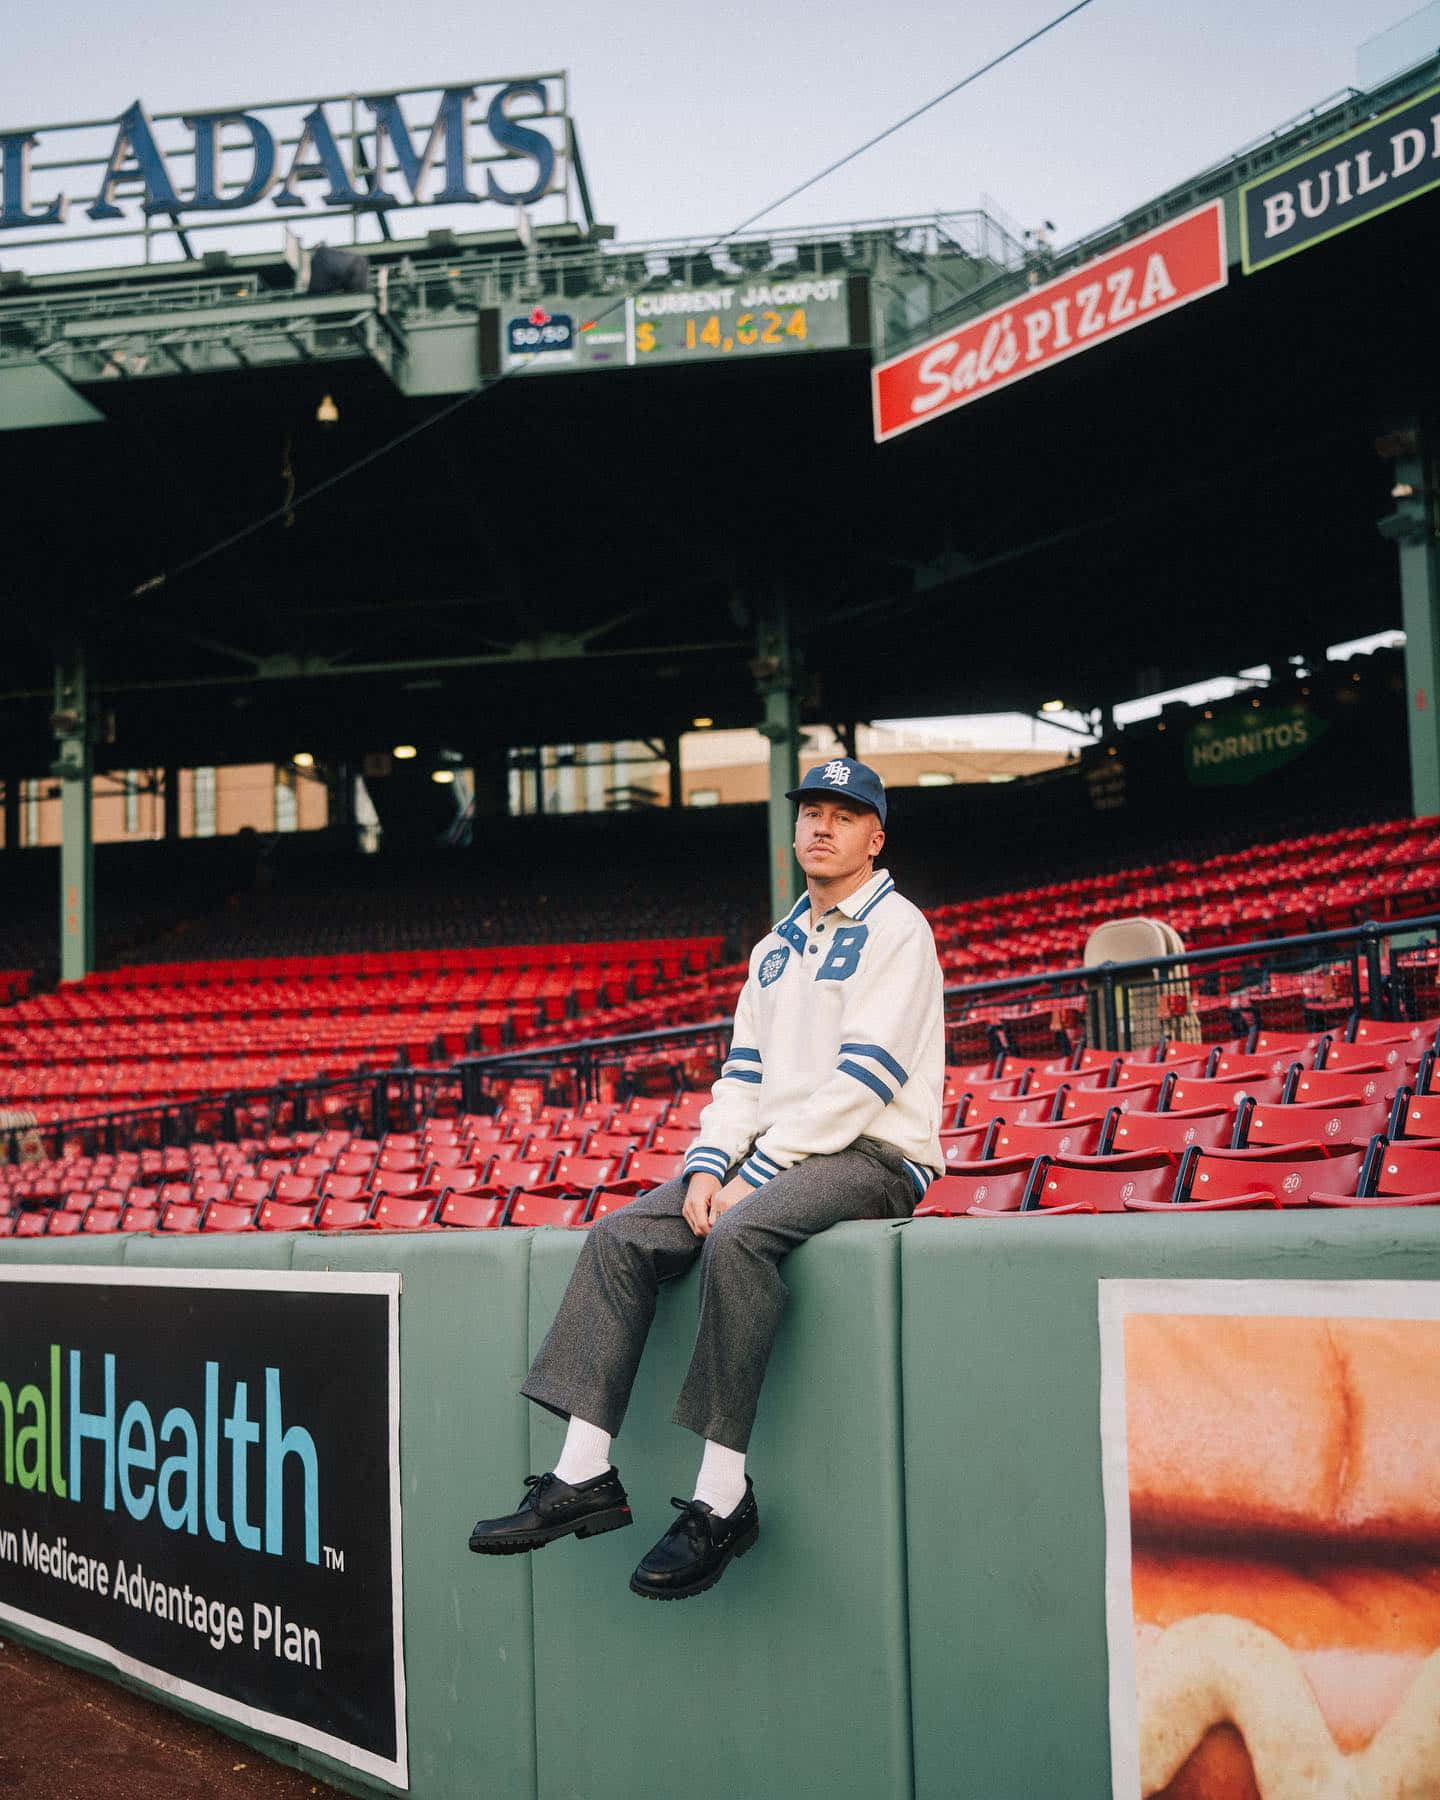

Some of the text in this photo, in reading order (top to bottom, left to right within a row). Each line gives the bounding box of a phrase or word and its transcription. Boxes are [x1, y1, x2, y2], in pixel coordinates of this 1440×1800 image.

[86, 80, 555, 219] ADAMS
[635, 280, 844, 316] CURRENT JACKPOT
[1022, 252, 1177, 362] PIZZA
[636, 322, 657, 351] $
[1193, 720, 1309, 767] HORNITOS
[814, 924, 869, 981] B
[22, 1527, 109, 1596] Medicare
[113, 1559, 244, 1650] Advantage
[253, 1602, 322, 1671] Plan
